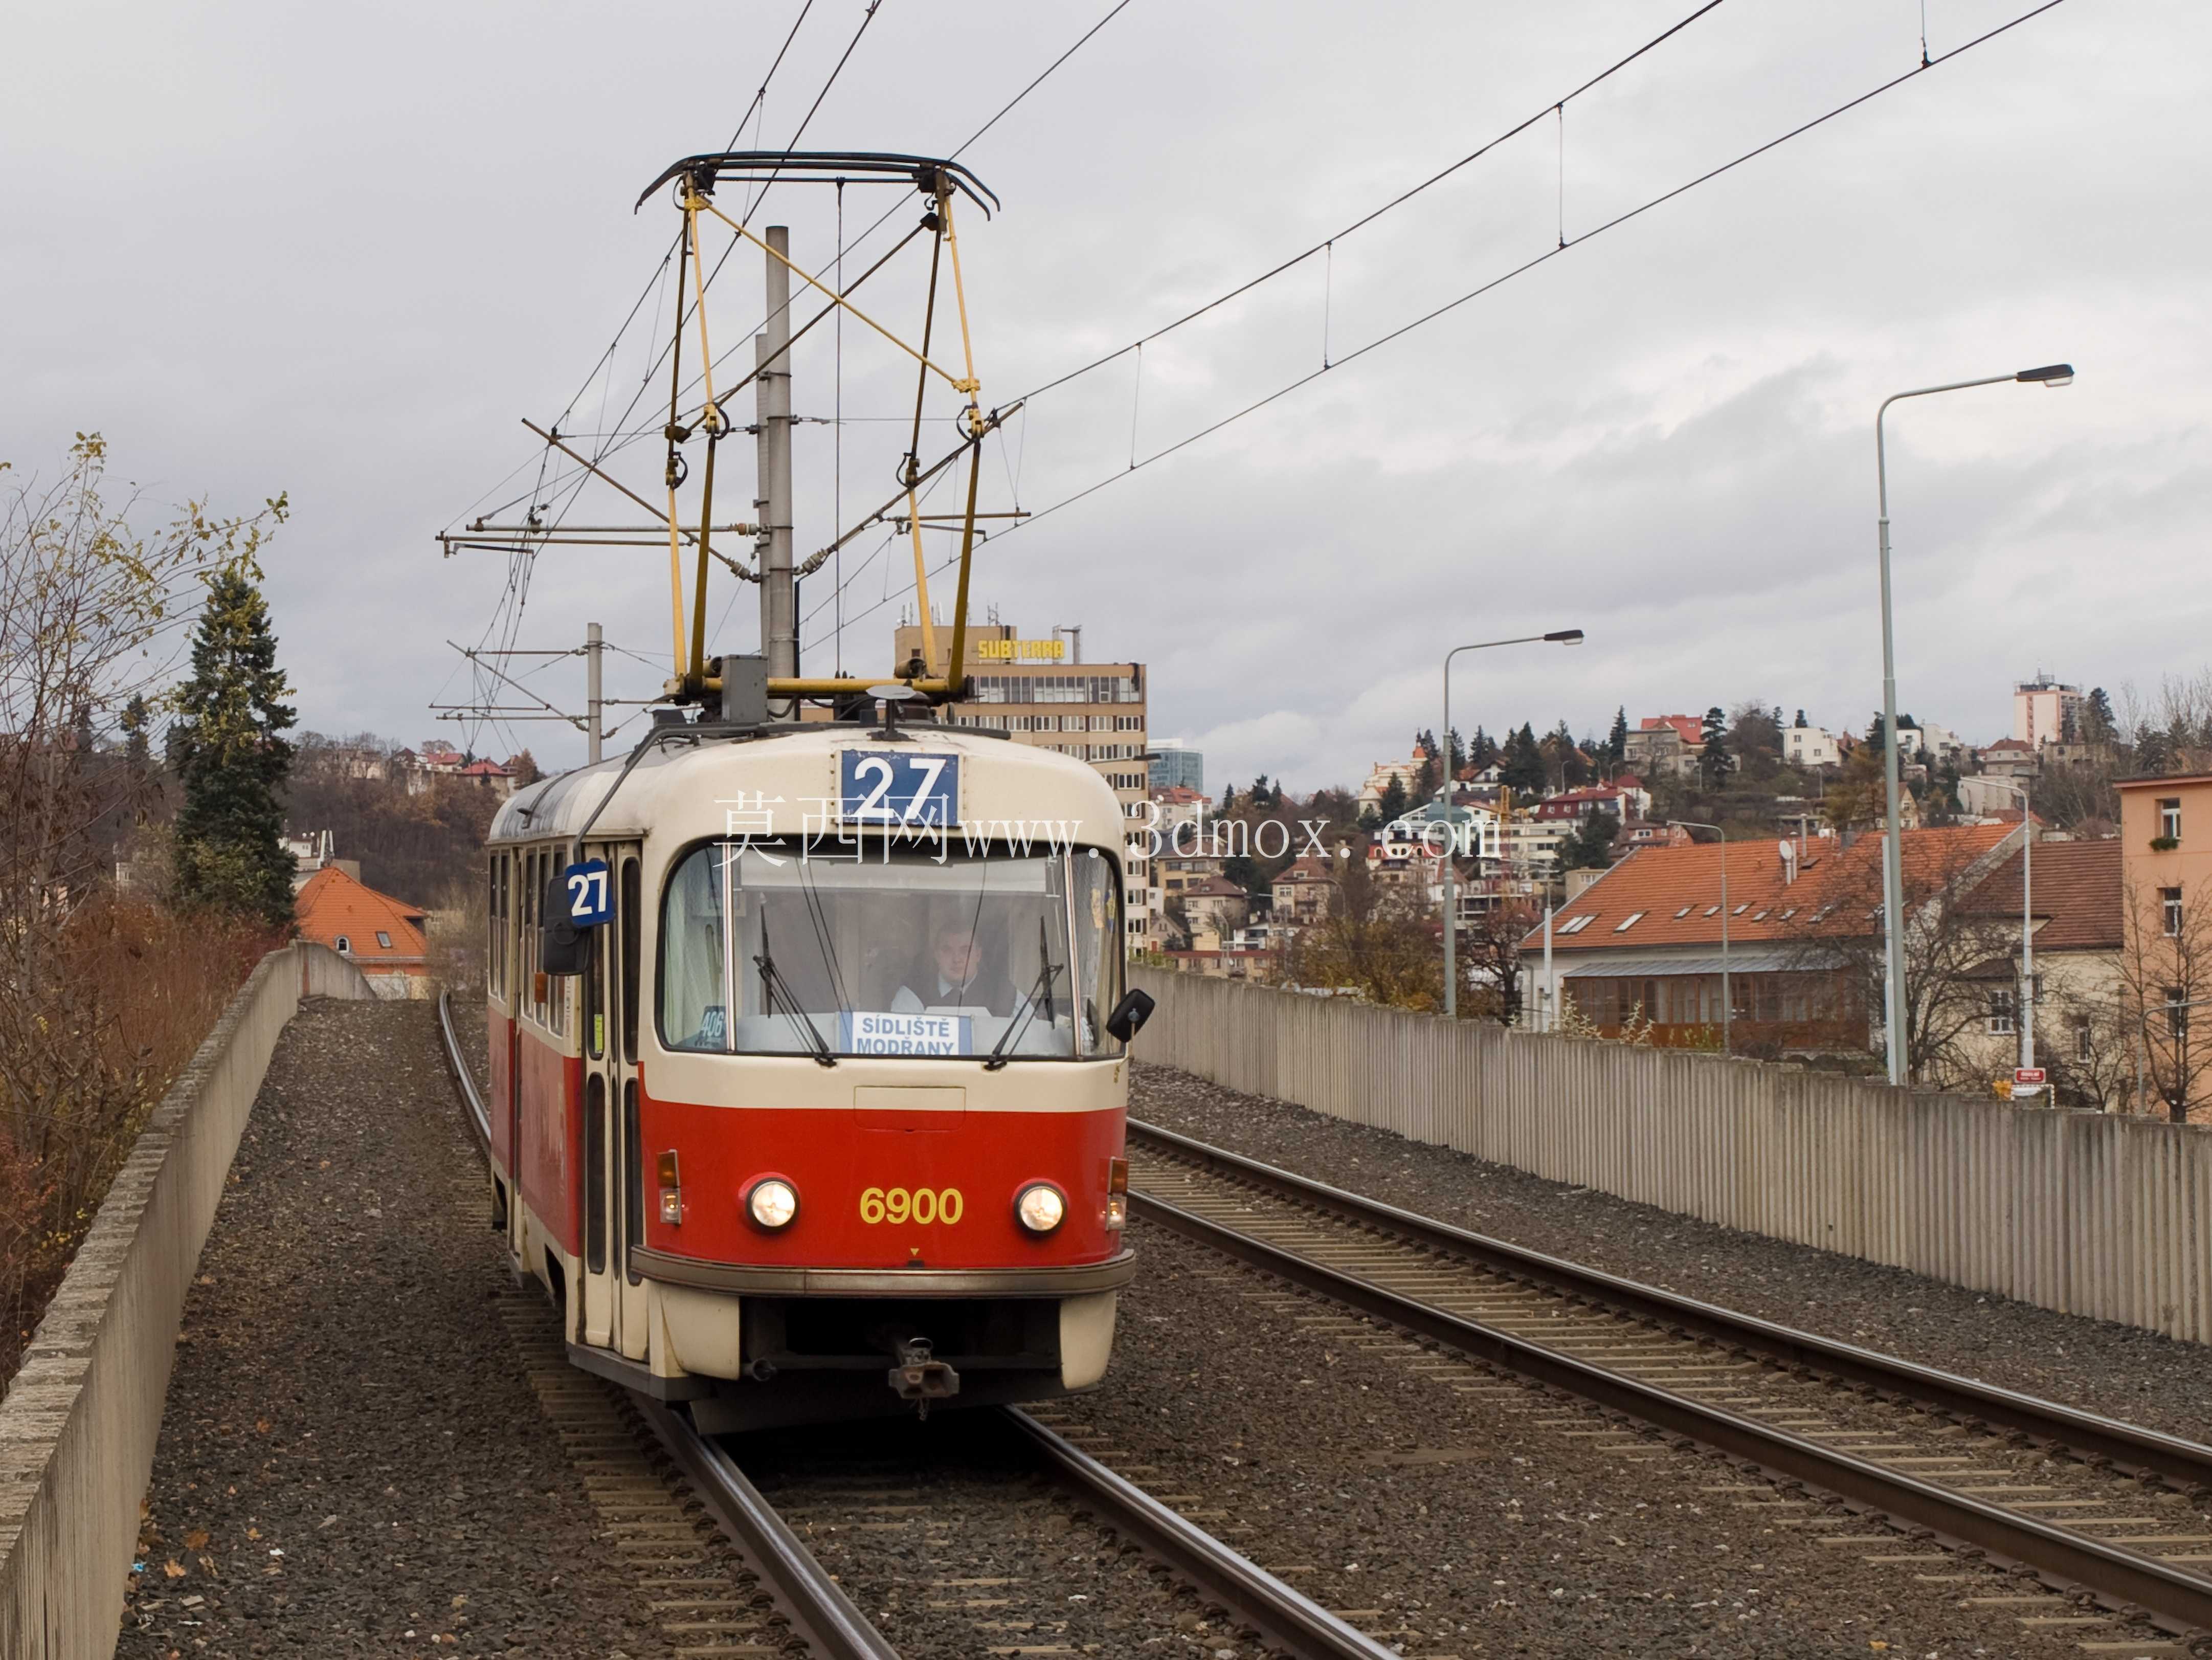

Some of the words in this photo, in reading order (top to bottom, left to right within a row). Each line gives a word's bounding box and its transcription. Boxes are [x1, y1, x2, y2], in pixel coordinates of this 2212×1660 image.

[978, 640, 1064, 658] SUBTERRA
[854, 757, 946, 820] 27
[568, 870, 608, 917] 27
[862, 1014, 950, 1037] SÍDLIŠTĚ
[857, 1036, 954, 1055] MODŘANY
[860, 1187, 964, 1225] 6900
